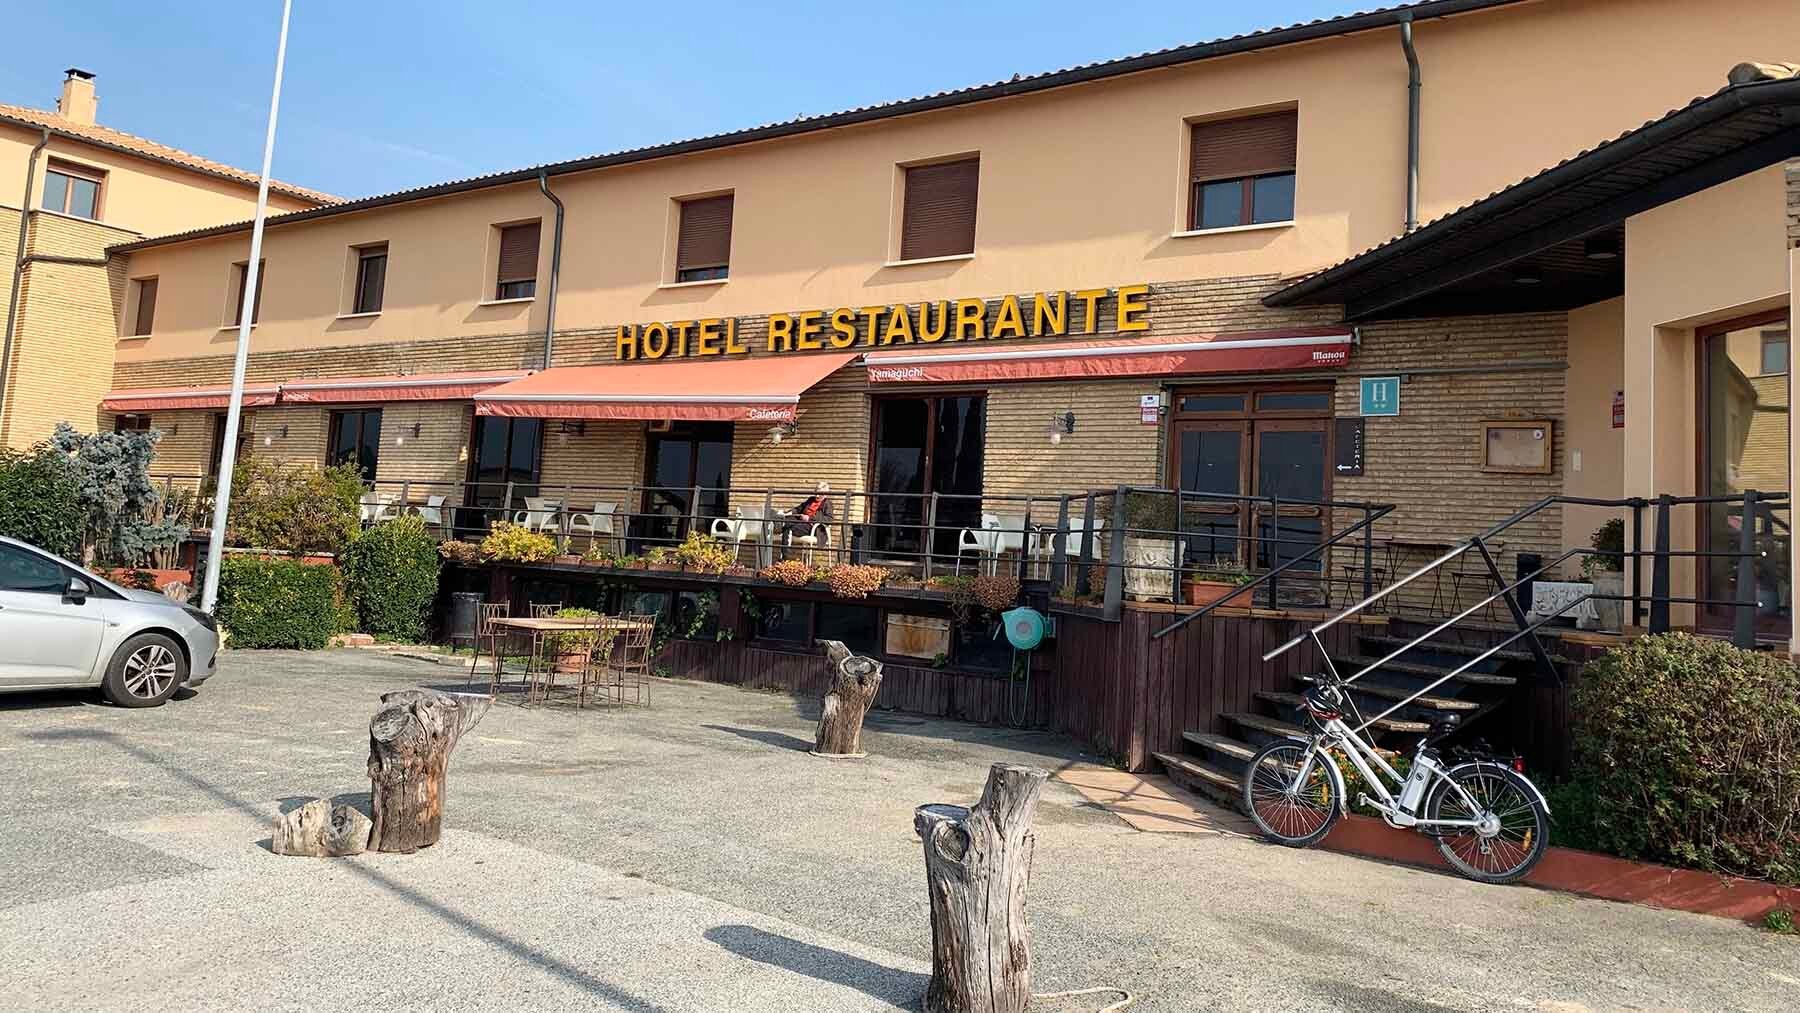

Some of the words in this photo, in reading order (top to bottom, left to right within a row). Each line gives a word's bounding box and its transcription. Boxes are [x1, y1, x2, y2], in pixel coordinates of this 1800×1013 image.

[616, 318, 746, 360] HOTEL
[767, 284, 1152, 352] RESTAURANTE
[868, 367, 923, 379] Yamaguchi
[1372, 382, 1388, 402] H
